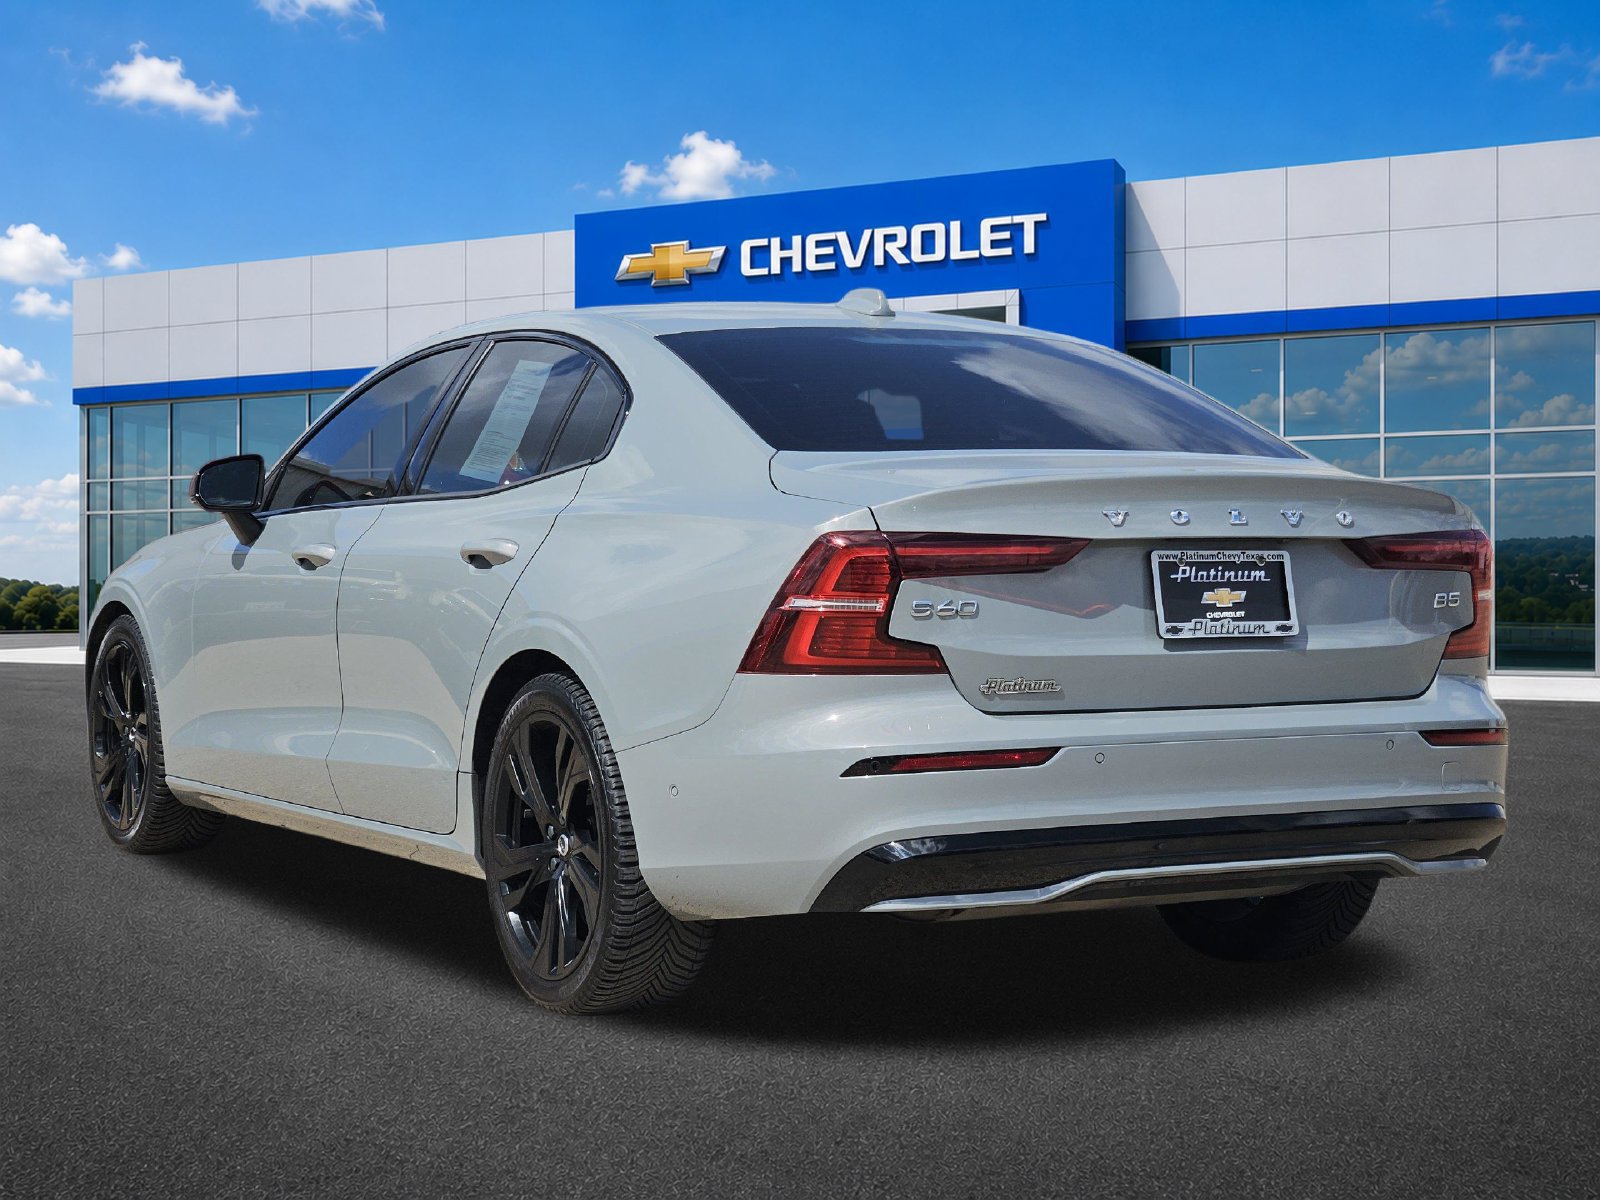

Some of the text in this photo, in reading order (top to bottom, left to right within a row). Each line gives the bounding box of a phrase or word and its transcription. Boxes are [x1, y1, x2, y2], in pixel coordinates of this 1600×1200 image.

[740, 213, 1047, 276] CHEVROLET
[1102, 508, 1353, 526] VOLVO
[1157, 551, 1284, 563] wwwPlatinumChevyTexa.com
[1170, 566, 1271, 582] Platinum
[1434, 592, 1460, 608] B5
[911, 600, 978, 617] S60
[1206, 611, 1246, 619] CHEVROLET
[1189, 621, 1271, 636] Platinum
[980, 677, 1062, 695] Platinum
